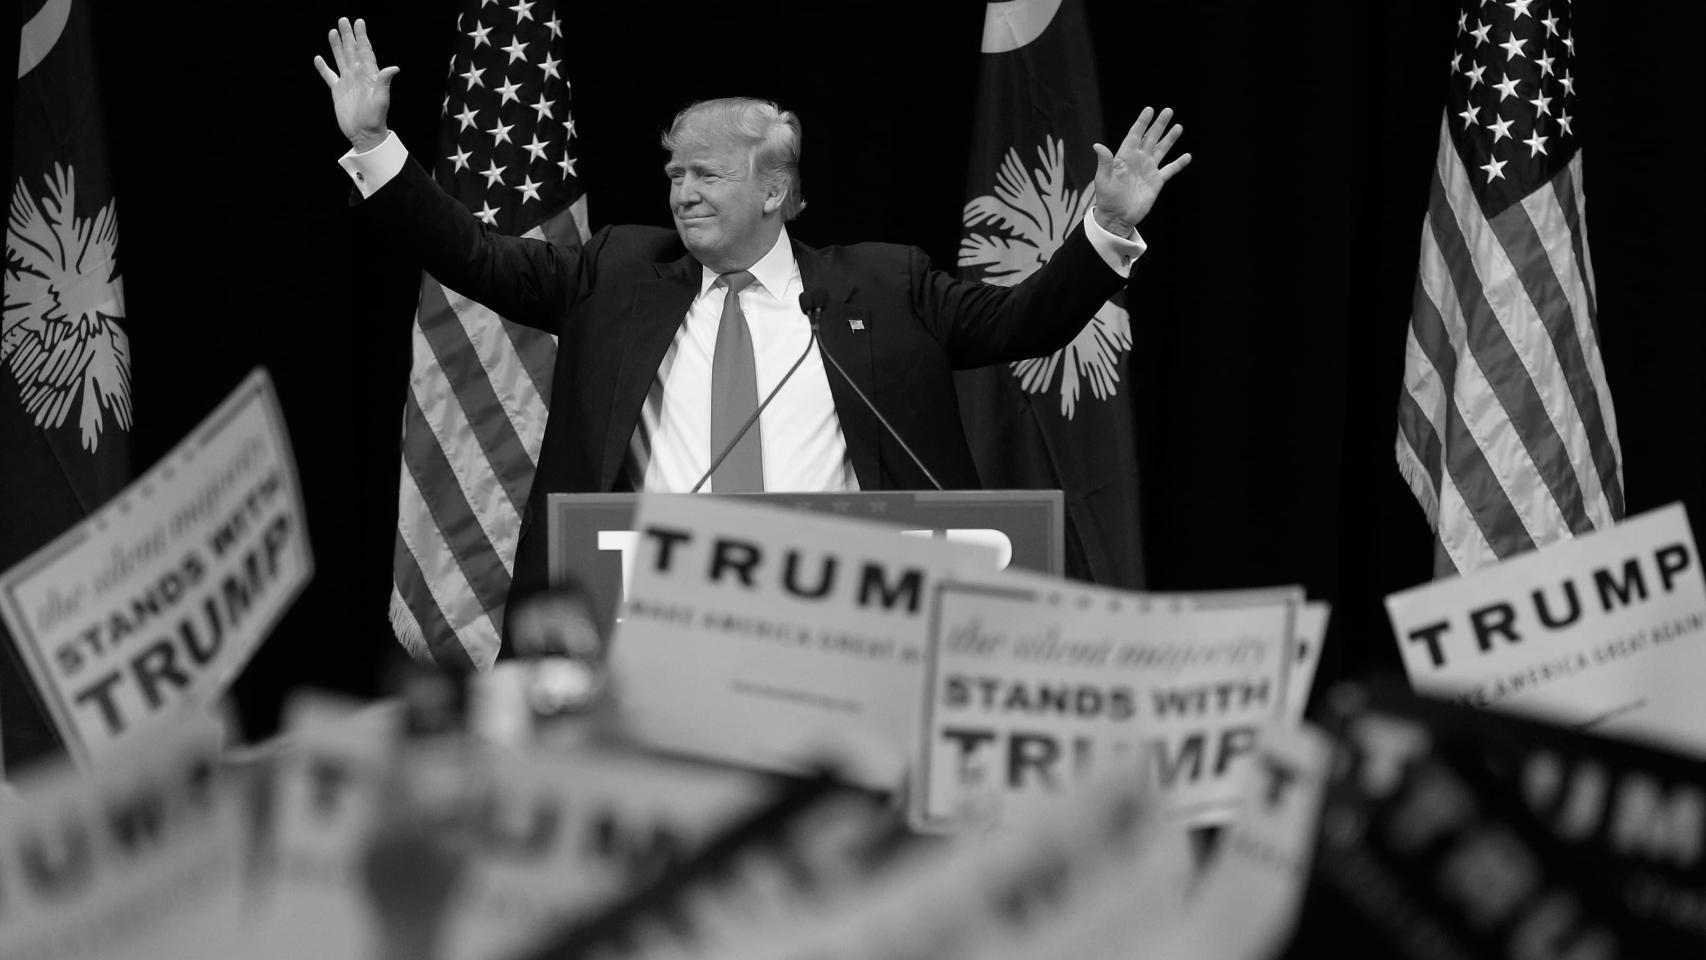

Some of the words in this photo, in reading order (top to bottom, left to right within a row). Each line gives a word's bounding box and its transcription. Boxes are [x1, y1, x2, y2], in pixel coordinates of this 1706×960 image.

[54, 551, 205, 678] STANDS
[644, 522, 926, 617] TRUM
[1406, 540, 1694, 670] TRUMP
[76, 513, 291, 738] TRUMP
[944, 672, 1138, 724] STANDS
[1150, 676, 1272, 722] WITH
[940, 723, 1262, 793] TRMP
